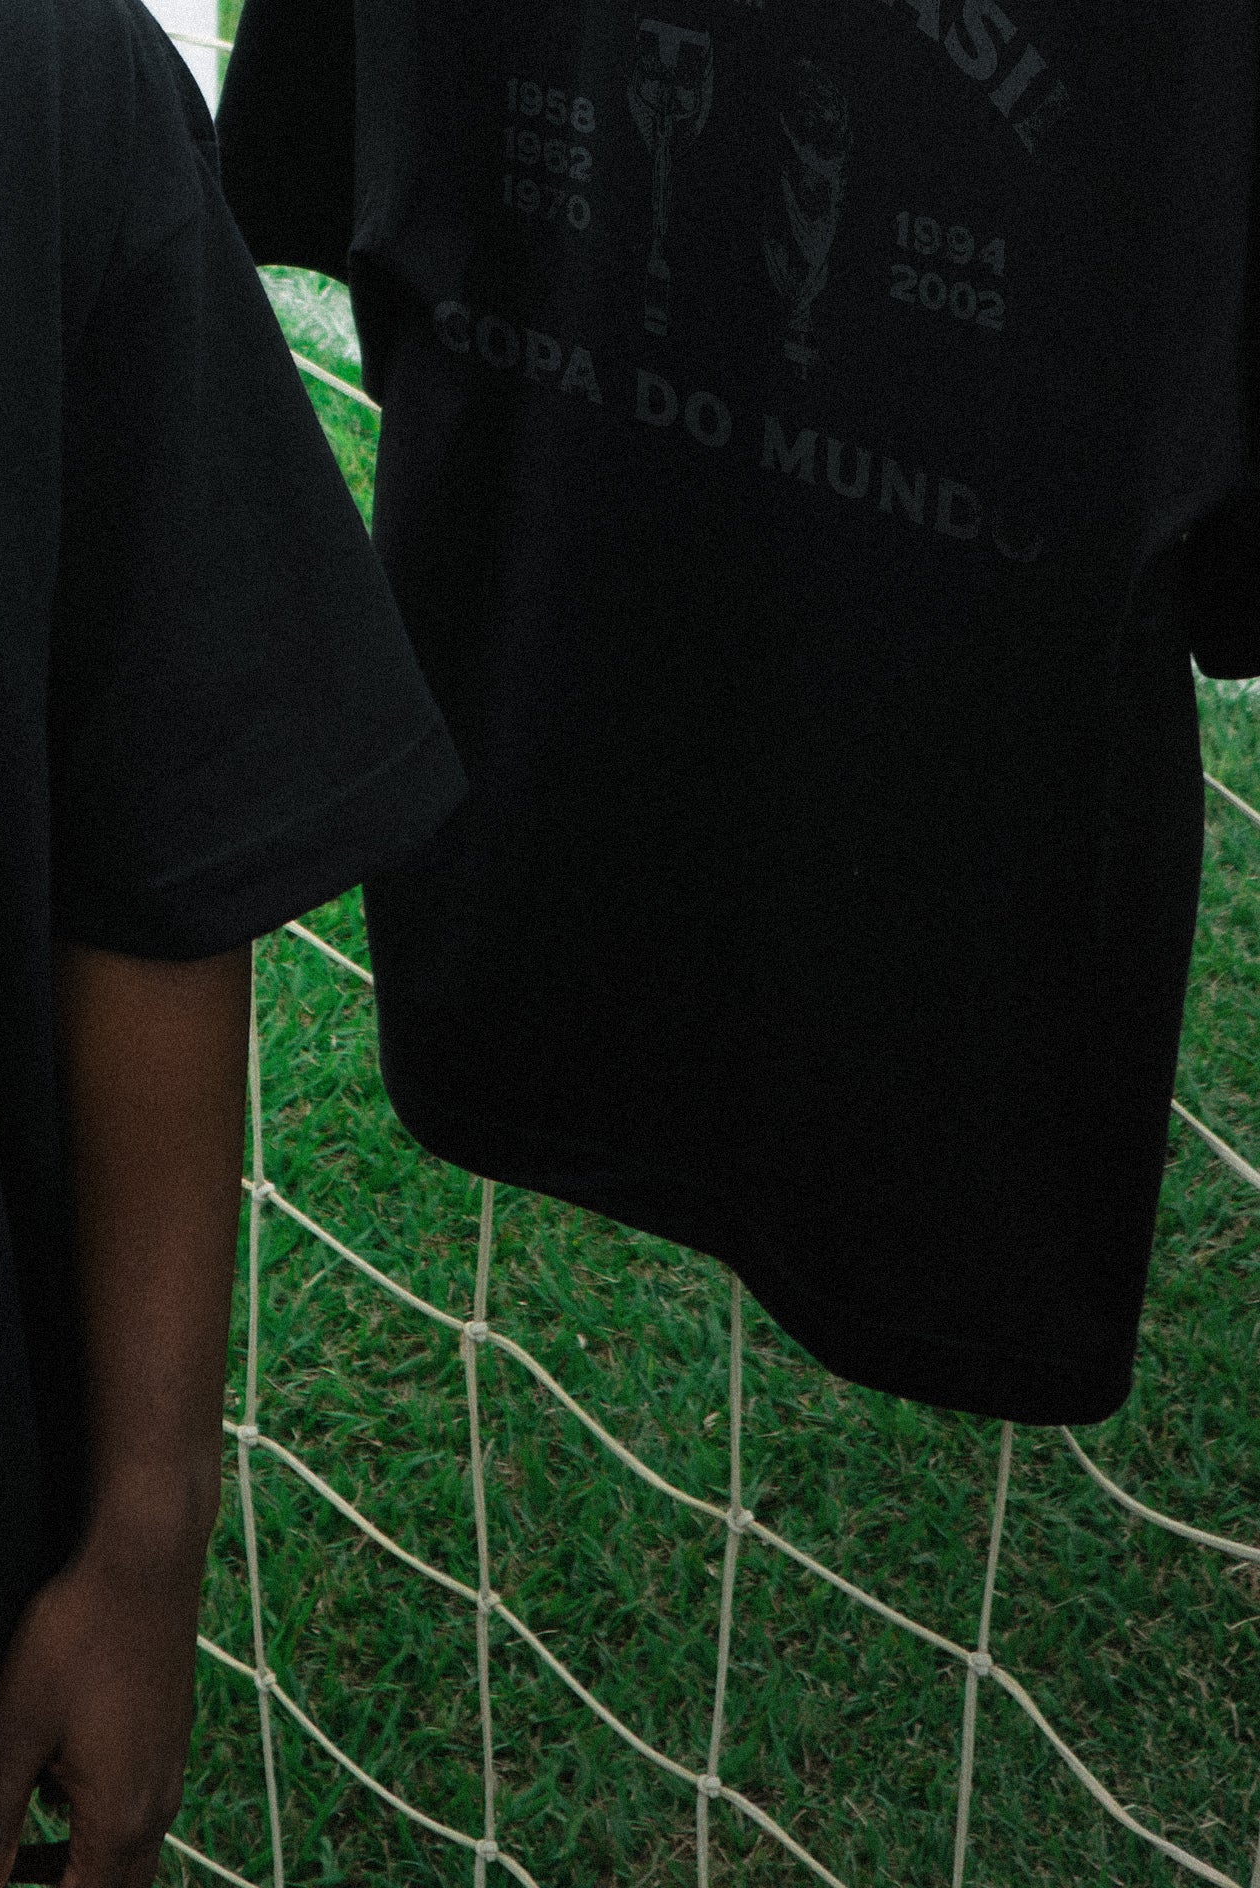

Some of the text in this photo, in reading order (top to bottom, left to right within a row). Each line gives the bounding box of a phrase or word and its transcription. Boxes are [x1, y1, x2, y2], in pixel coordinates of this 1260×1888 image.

[505, 76, 598, 134] 1958
[503, 126, 594, 183] 1962
[502, 173, 592, 231] 1970
[895, 209, 1007, 276] 1994
[888, 263, 1007, 332] 2002
[433, 299, 604, 405] COPA
[632, 365, 734, 448] DO
